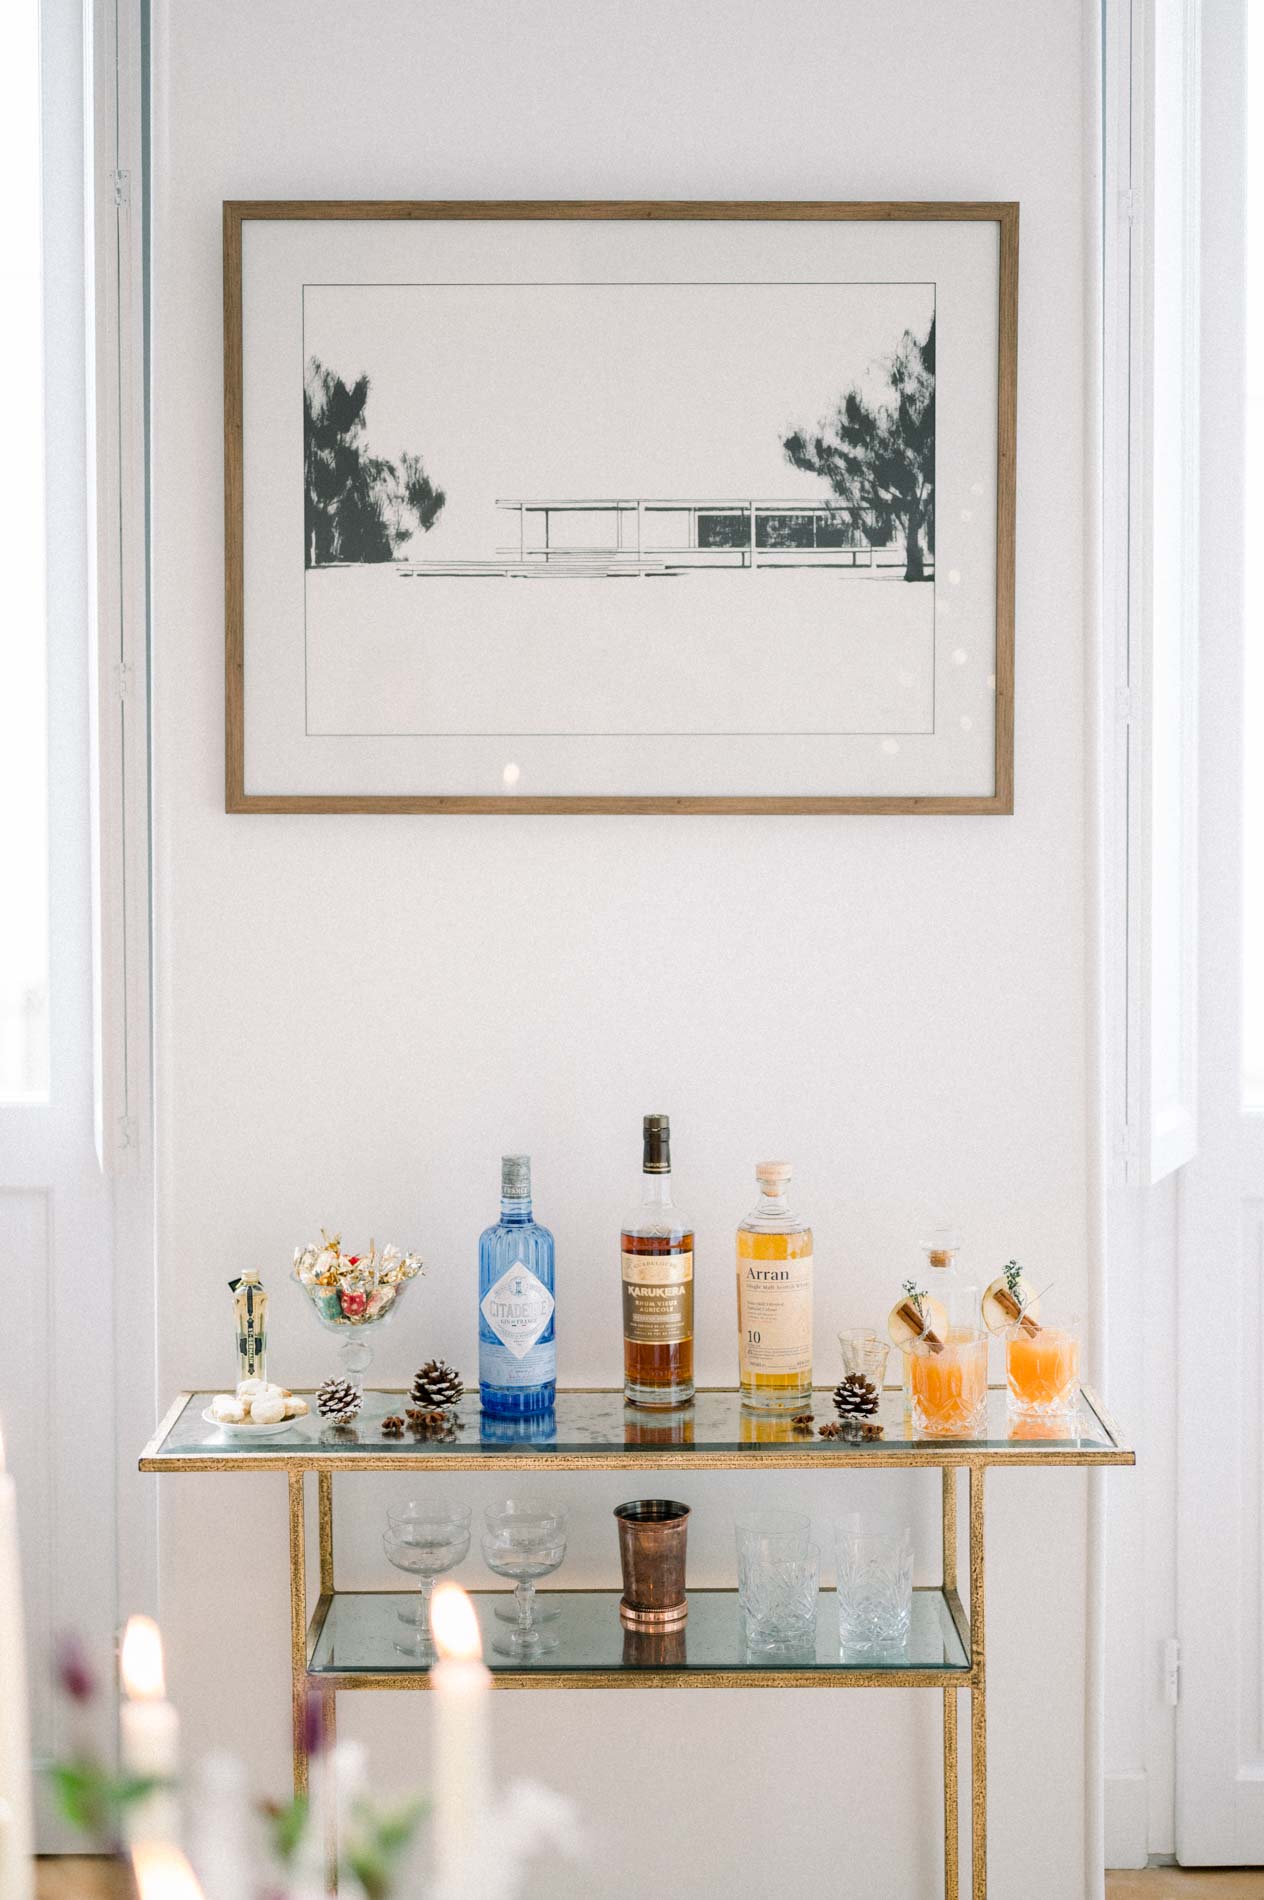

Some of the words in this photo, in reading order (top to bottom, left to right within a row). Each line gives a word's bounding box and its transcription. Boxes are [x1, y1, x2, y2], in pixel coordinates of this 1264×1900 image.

[746, 1267, 789, 1280] Arran
[627, 1286, 686, 1299] KARUKERA
[747, 1330, 761, 1343] 10
